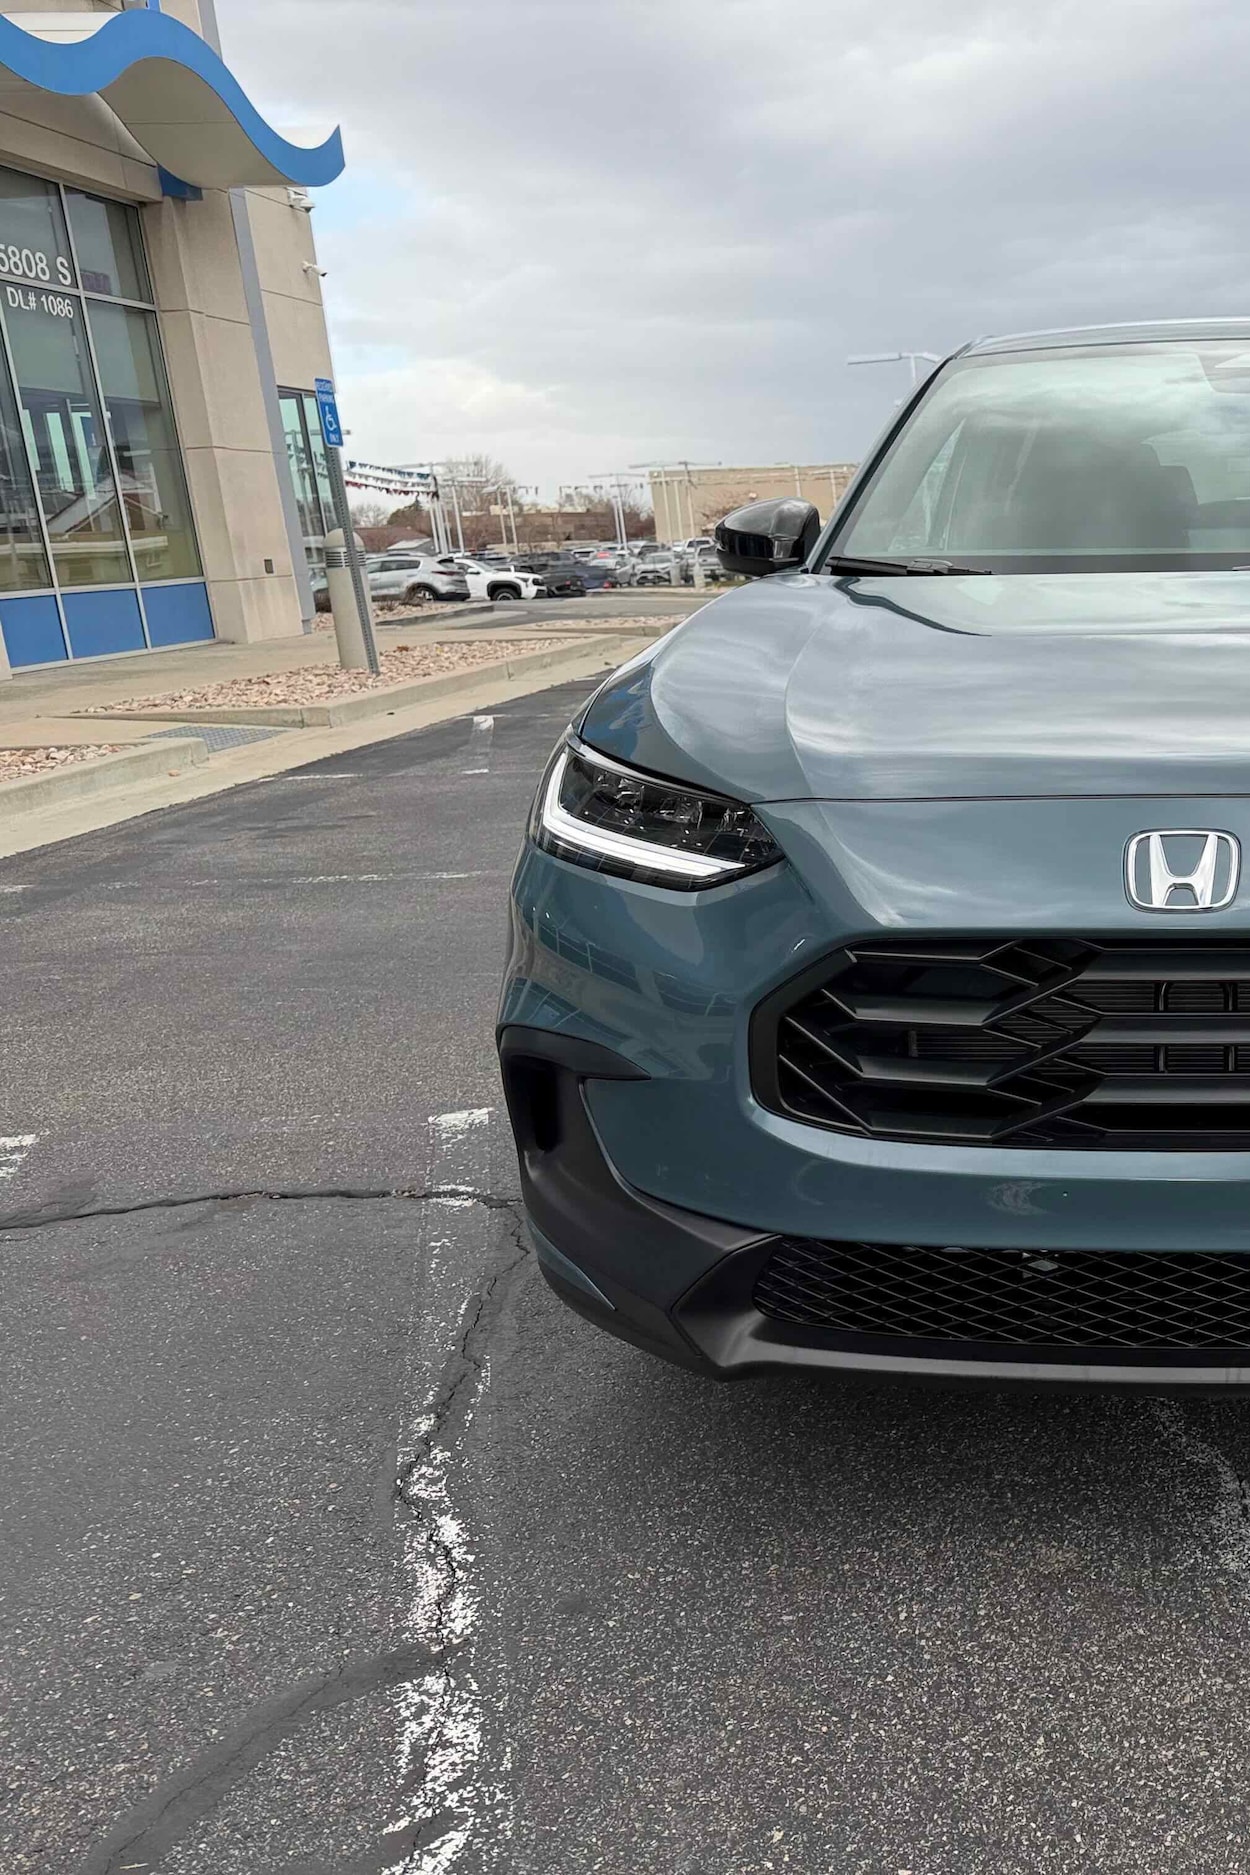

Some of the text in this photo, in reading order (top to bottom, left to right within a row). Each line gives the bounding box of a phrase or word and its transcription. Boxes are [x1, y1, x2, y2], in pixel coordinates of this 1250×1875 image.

[0, 243, 72, 286] 5808 S
[6, 286, 74, 319] DL# 1086
